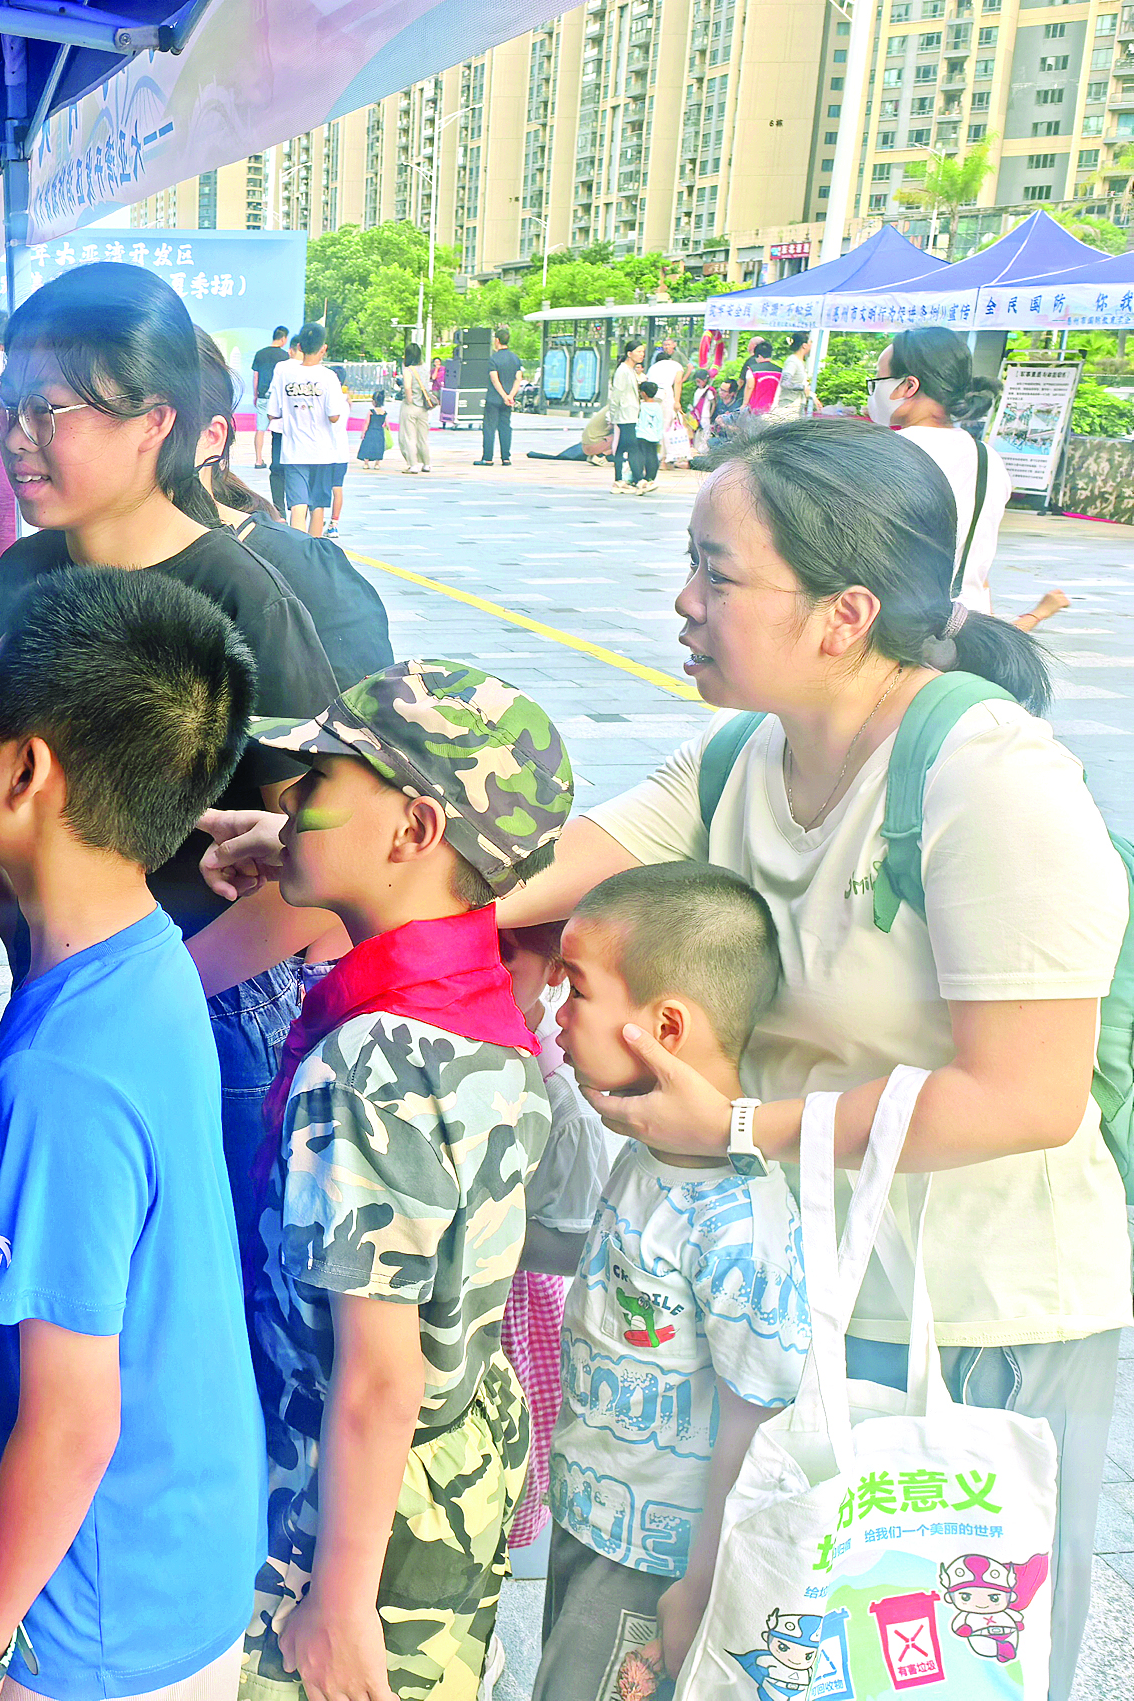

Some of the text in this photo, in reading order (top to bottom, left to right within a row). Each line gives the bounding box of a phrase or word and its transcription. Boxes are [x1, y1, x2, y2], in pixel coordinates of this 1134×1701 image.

[985, 293, 1066, 315] 全民国防
[865, 1522, 1004, 1543] 给我们一个美丽的世界
[898, 1659, 937, 1677] 有害垃圾
